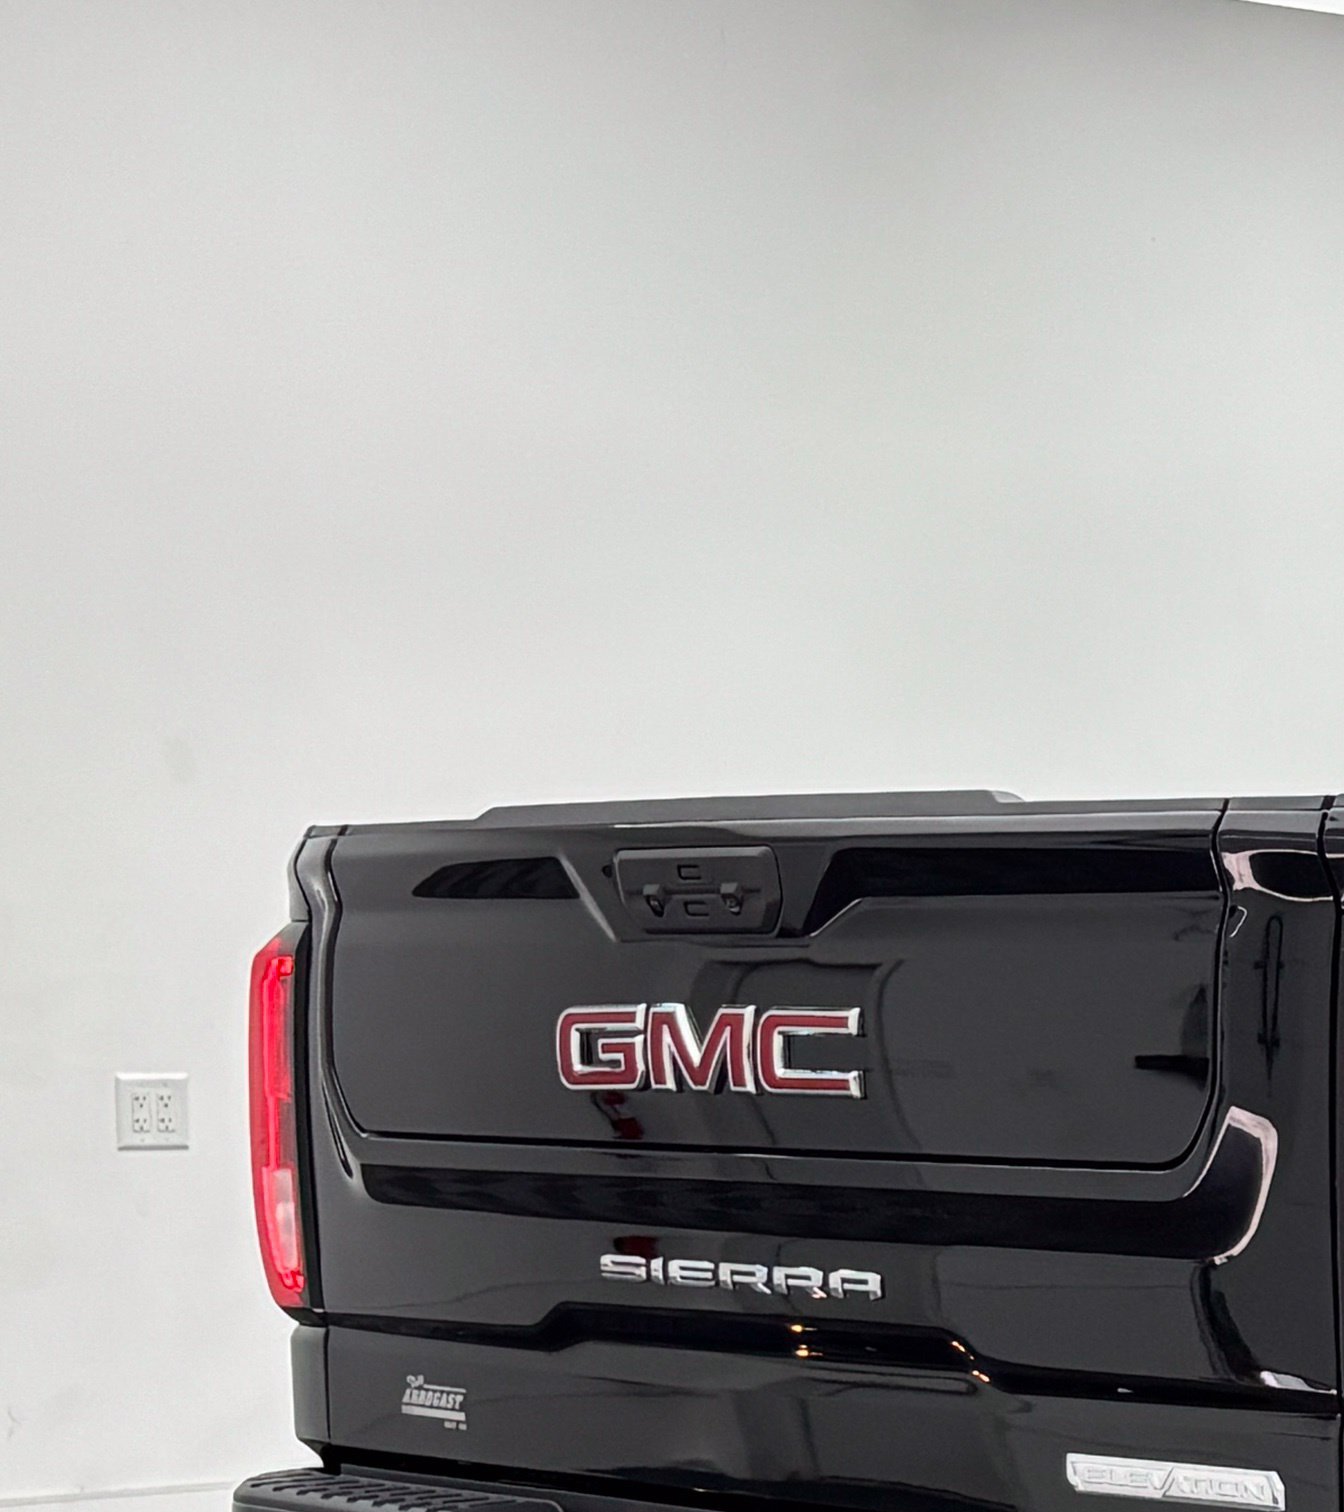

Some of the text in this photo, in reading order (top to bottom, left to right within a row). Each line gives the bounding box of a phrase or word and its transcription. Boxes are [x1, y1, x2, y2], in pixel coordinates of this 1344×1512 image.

[556, 1002, 867, 1100] GMC
[600, 1254, 882, 1301] SIERRA
[1081, 1464, 1271, 1502] ELEVATION
